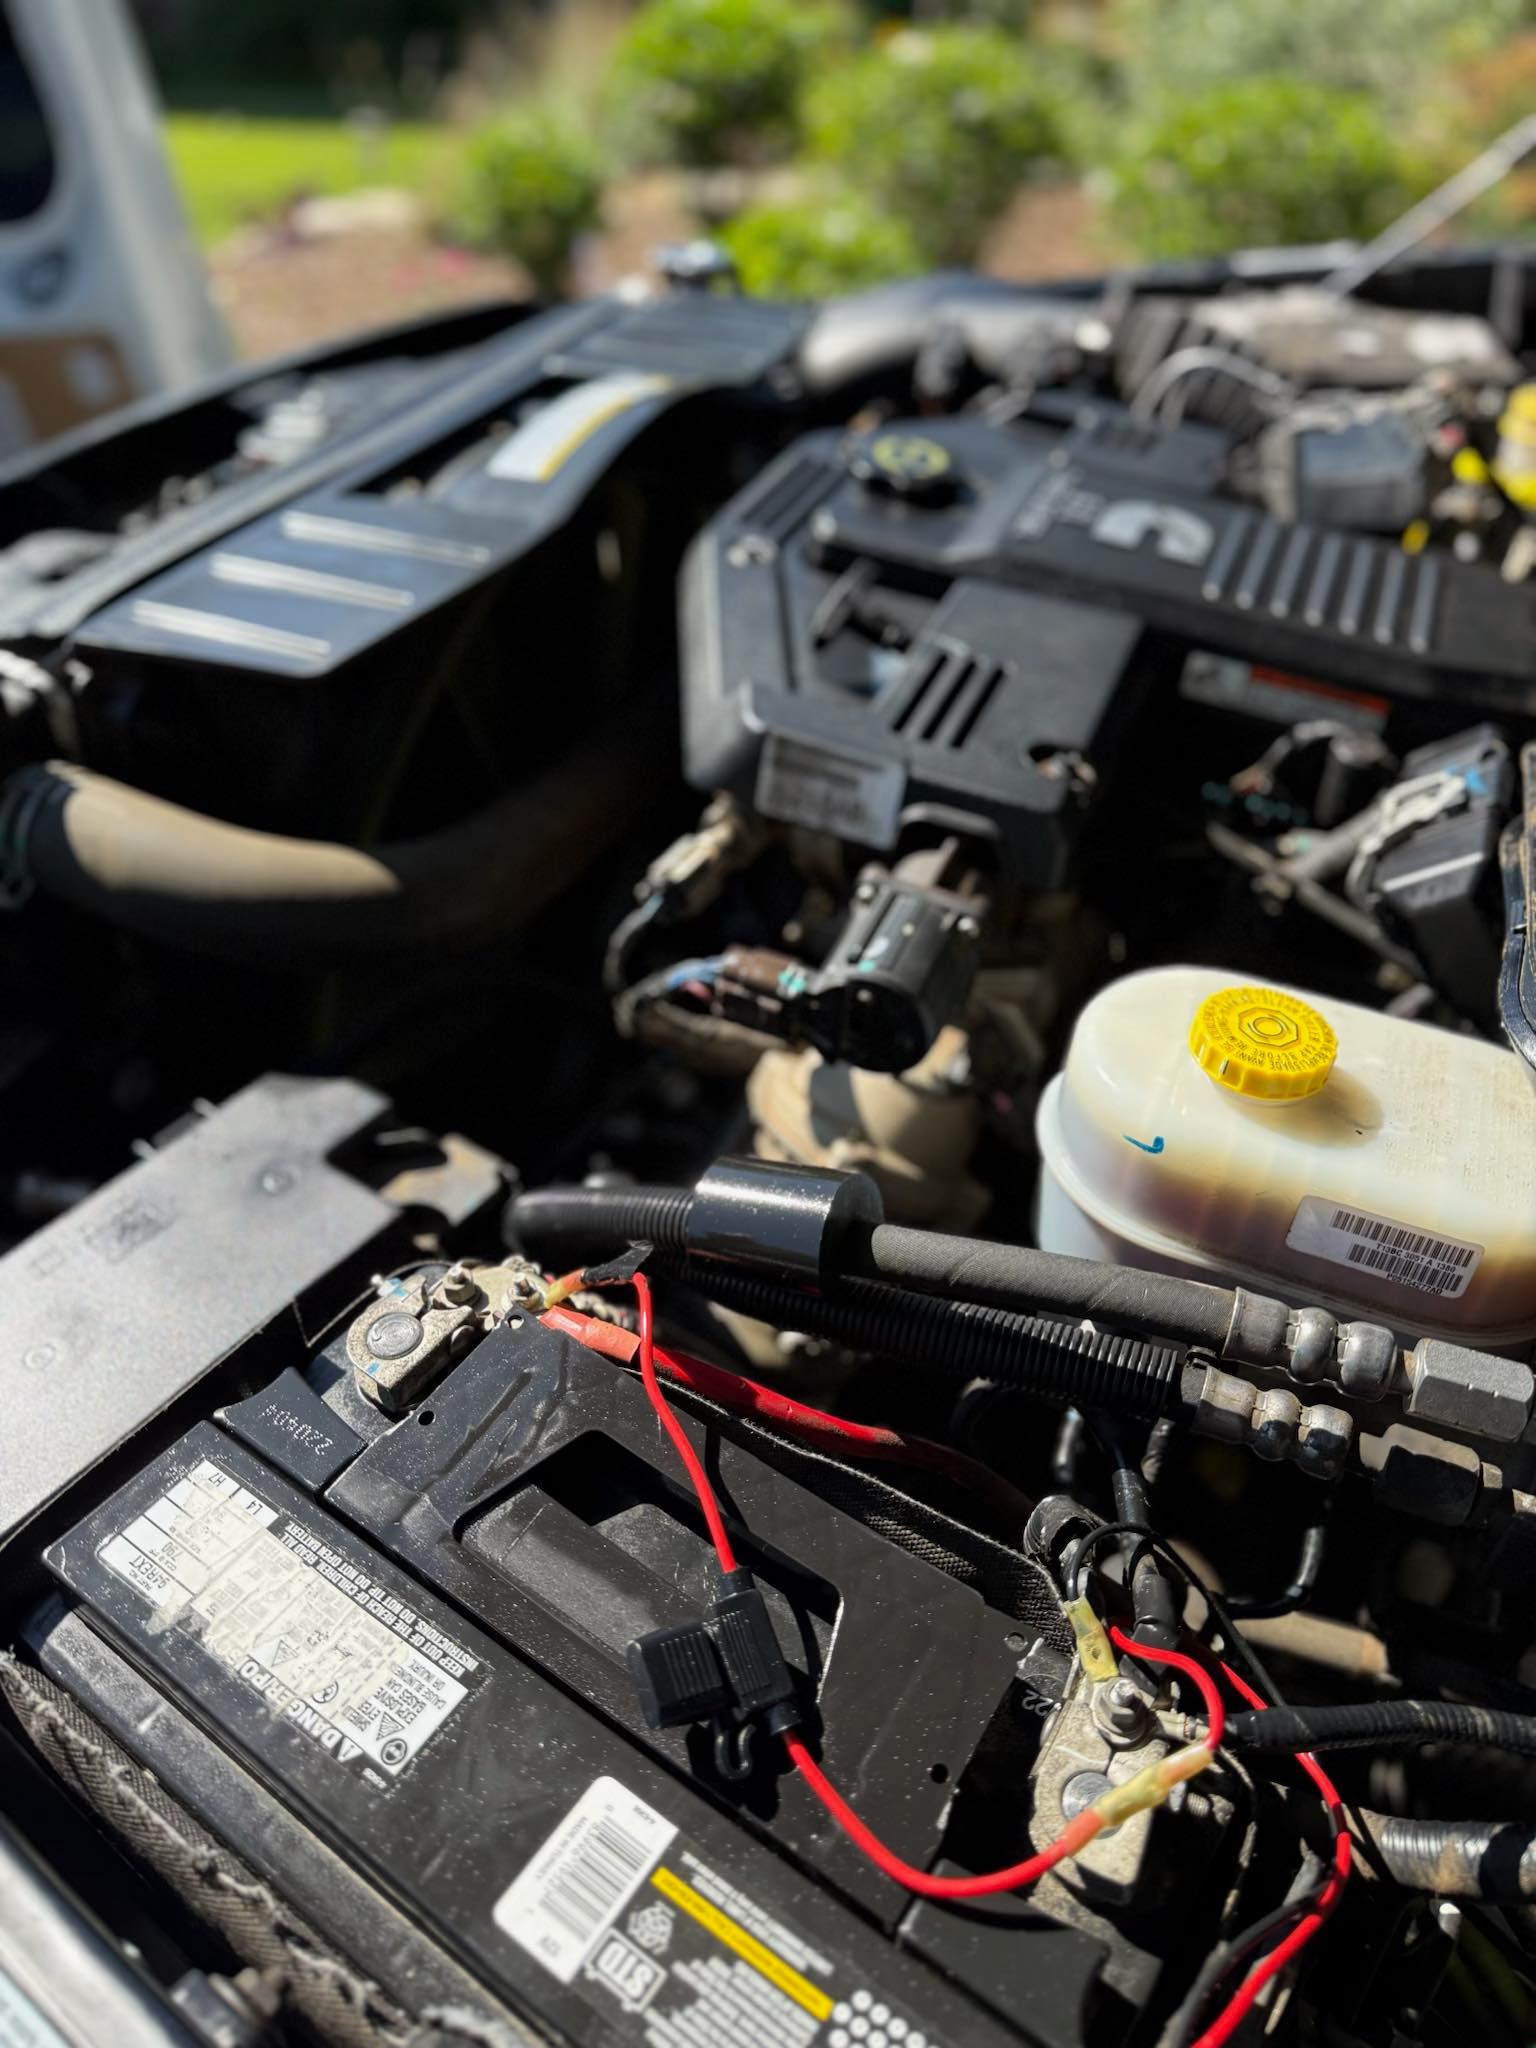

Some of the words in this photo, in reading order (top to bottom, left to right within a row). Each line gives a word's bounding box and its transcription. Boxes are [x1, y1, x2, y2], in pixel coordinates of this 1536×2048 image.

[205, 1469, 227, 1488] H7
[243, 1497, 264, 1516] L4
[277, 1531, 299, 1549] ALL
[282, 1519, 322, 1552] BATTERY.
[158, 1539, 186, 1562] 790
[291, 1542, 319, 1566] READ
[315, 1543, 344, 1568] OPEN
[125, 1552, 172, 1590] 94REXT
[335, 1560, 359, 1581] NOT
[352, 1573, 372, 1590] DO
[352, 1588, 371, 1605] OF
[366, 1582, 387, 1600] TIP.
[364, 1598, 397, 1626] REACH
[380, 1593, 404, 1614] NOT
[397, 1606, 417, 1624] DO
[390, 1618, 413, 1638] THE
[406, 1630, 426, 1648] OF
[411, 1616, 480, 1672] INSTRUCTIONS.
[419, 1639, 444, 1661] OUT
[436, 1653, 466, 1678] KEEP
[371, 1685, 418, 1725] EXPLOSIVE
[397, 1687, 427, 1714] GASES
[592, 1935, 659, 2001] STD
